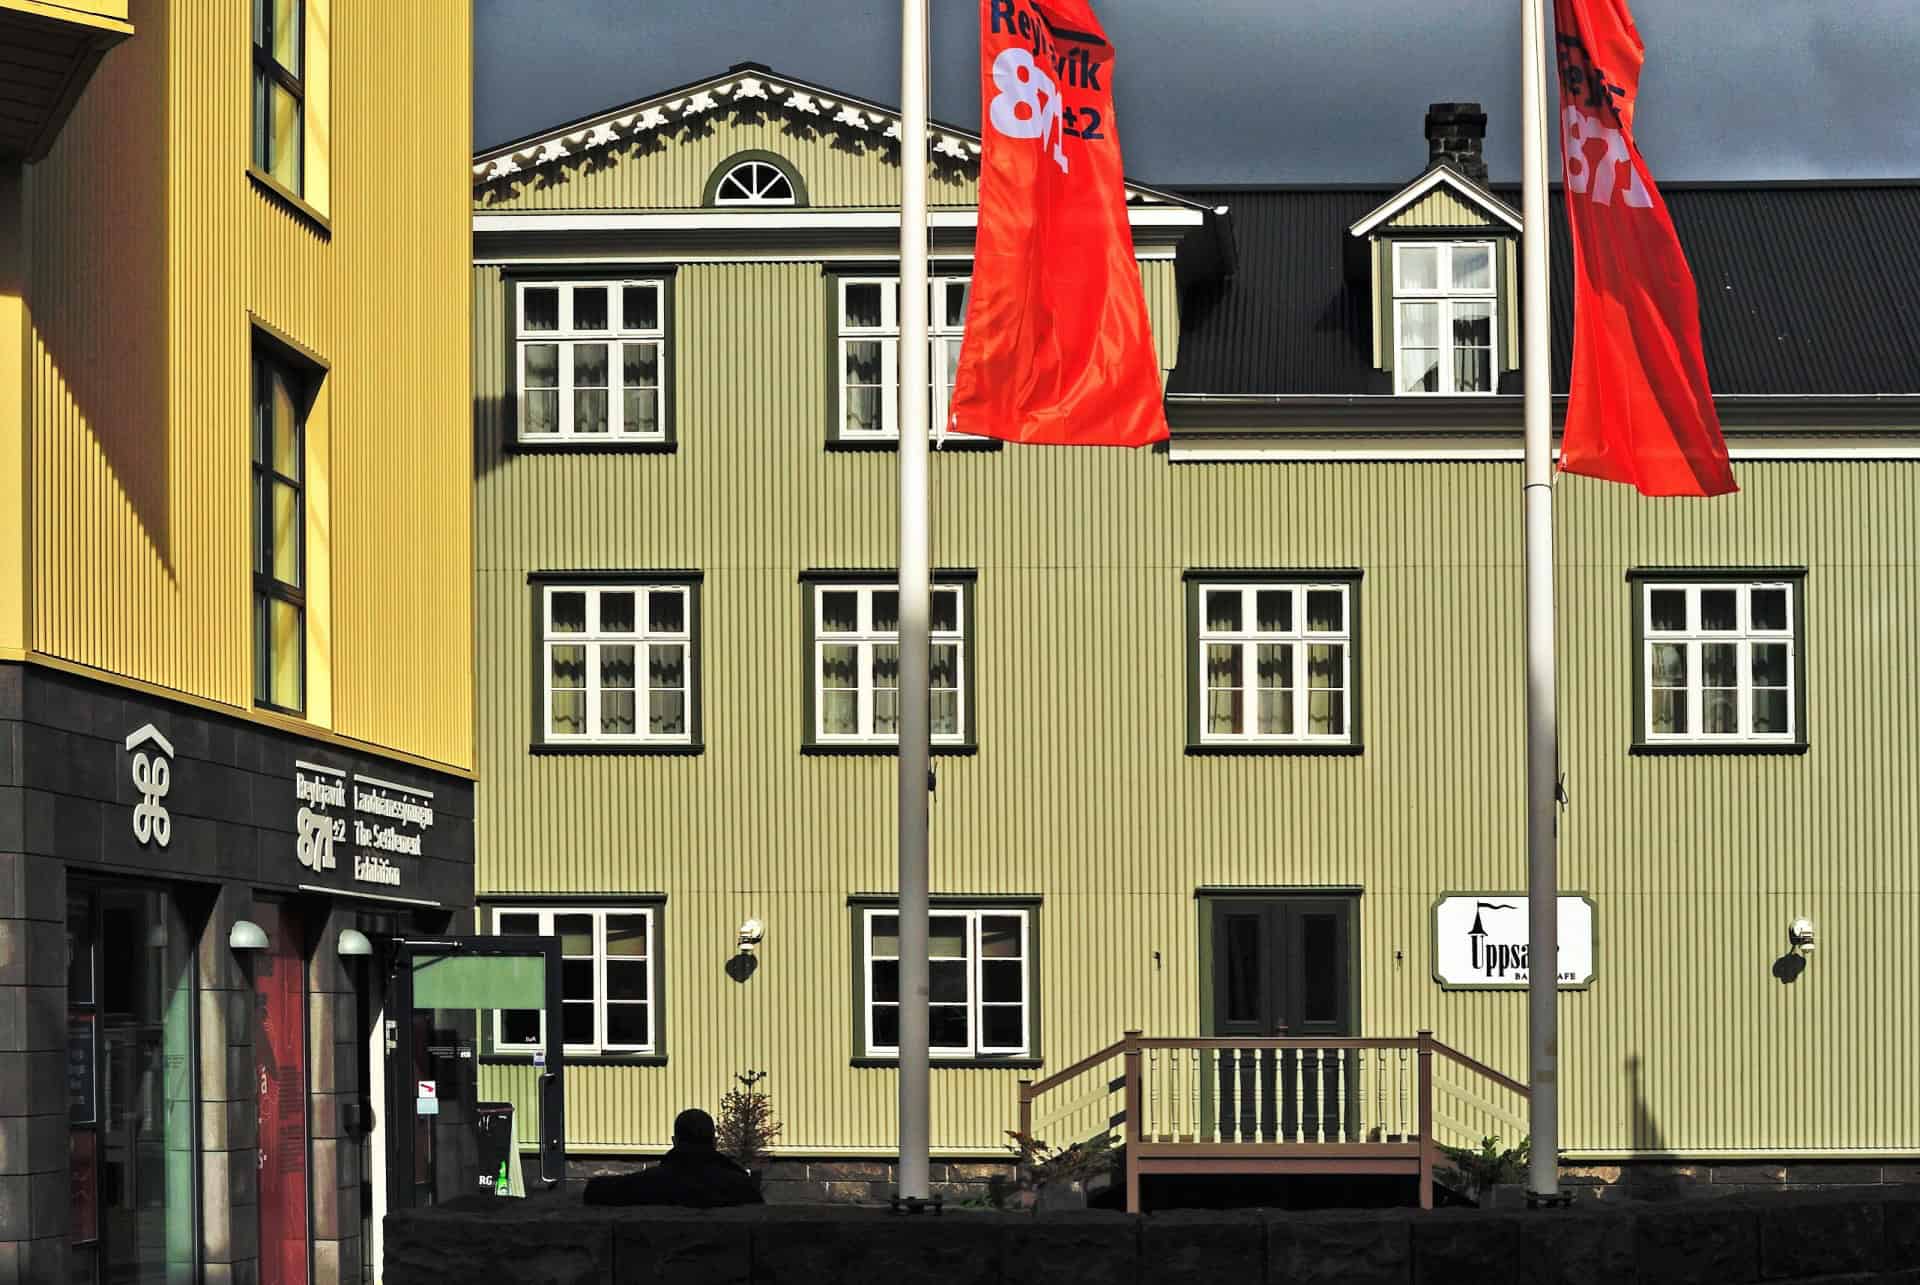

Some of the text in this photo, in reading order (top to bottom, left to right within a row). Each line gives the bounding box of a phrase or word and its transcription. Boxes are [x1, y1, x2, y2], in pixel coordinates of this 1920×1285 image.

[354, 820, 421, 856] The Settlement
[354, 855, 400, 886] Exhibition
